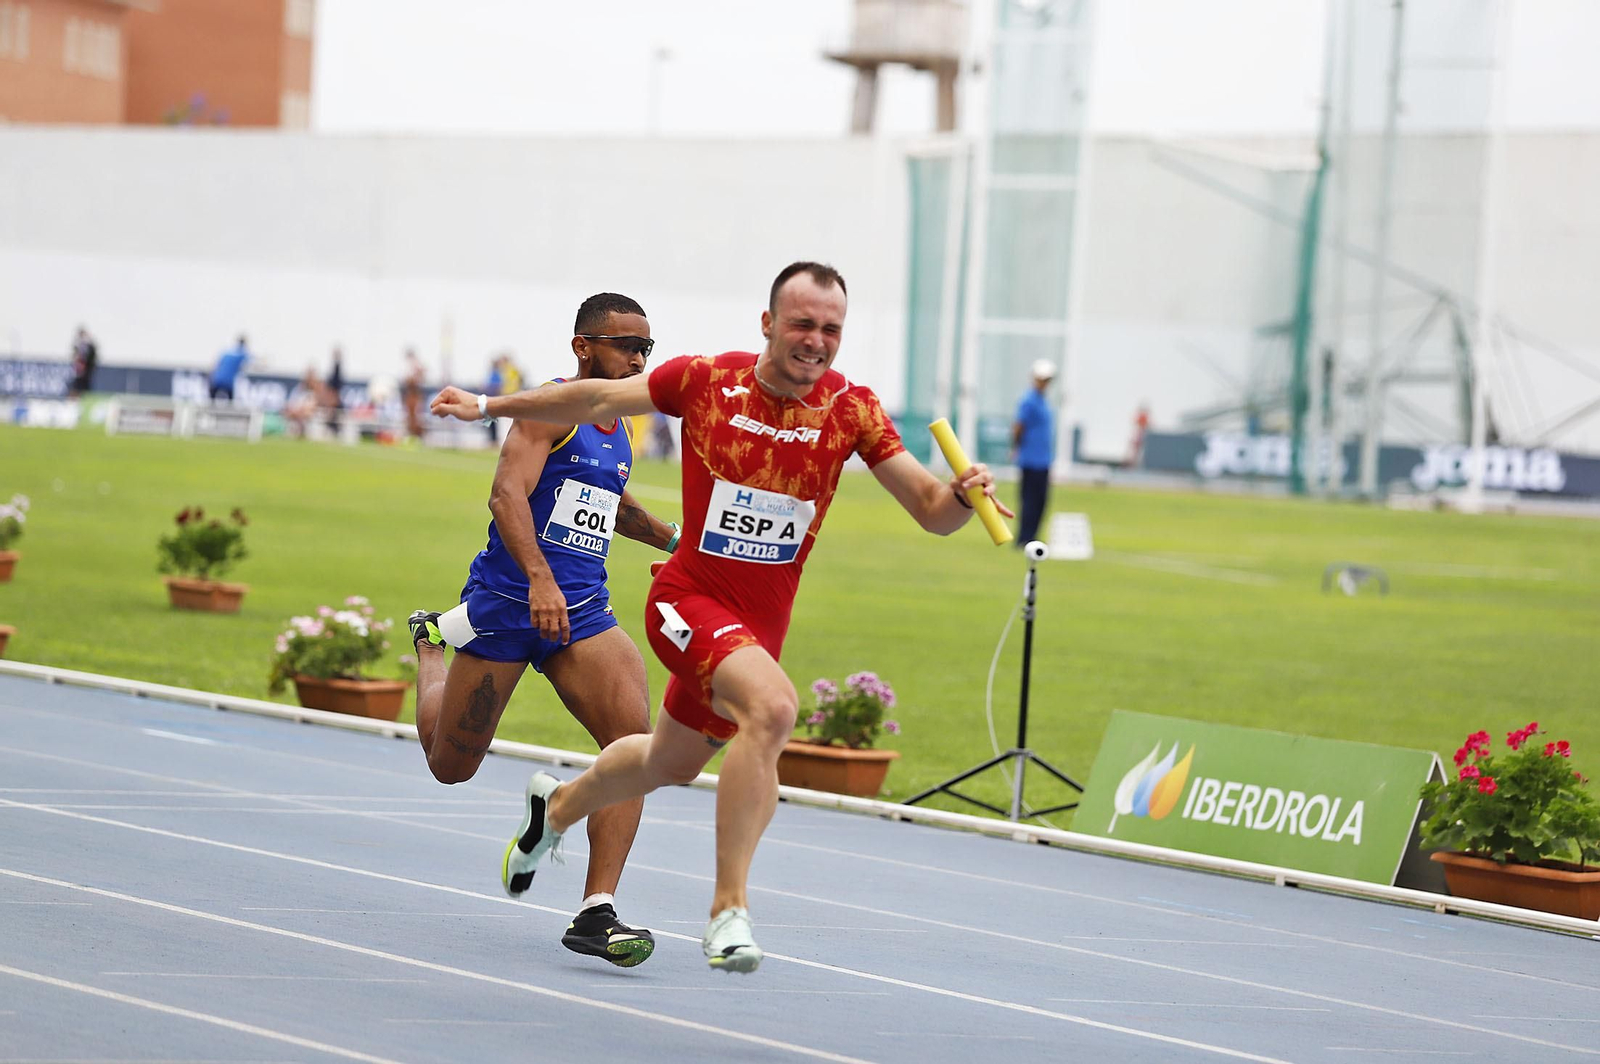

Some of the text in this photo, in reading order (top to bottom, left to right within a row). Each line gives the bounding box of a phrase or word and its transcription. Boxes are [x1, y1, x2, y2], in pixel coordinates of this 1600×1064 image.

[728, 413, 822, 443] ESPAÑA
[573, 508, 608, 534] COL
[719, 510, 774, 537] ESP
[778, 522, 796, 540] A
[1182, 776, 1365, 846] IBERDROLA
